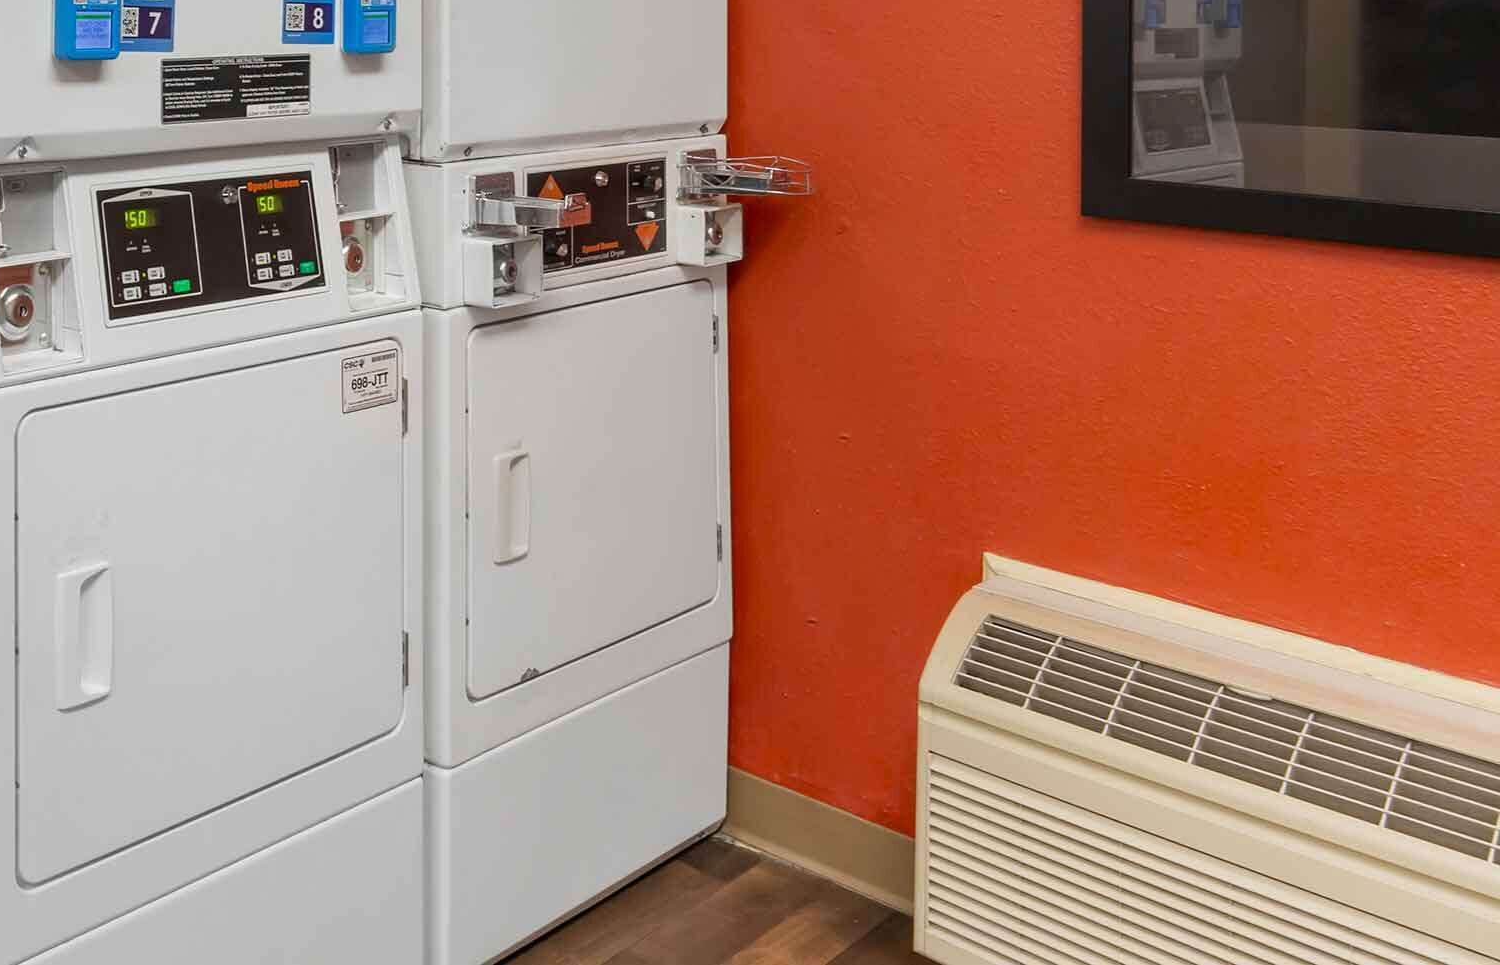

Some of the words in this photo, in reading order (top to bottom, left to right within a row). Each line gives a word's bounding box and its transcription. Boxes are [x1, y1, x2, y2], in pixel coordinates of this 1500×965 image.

[149, 12, 162, 35] 7
[313, 8, 324, 29] 8
[351, 372, 389, 390] 698-JTT
